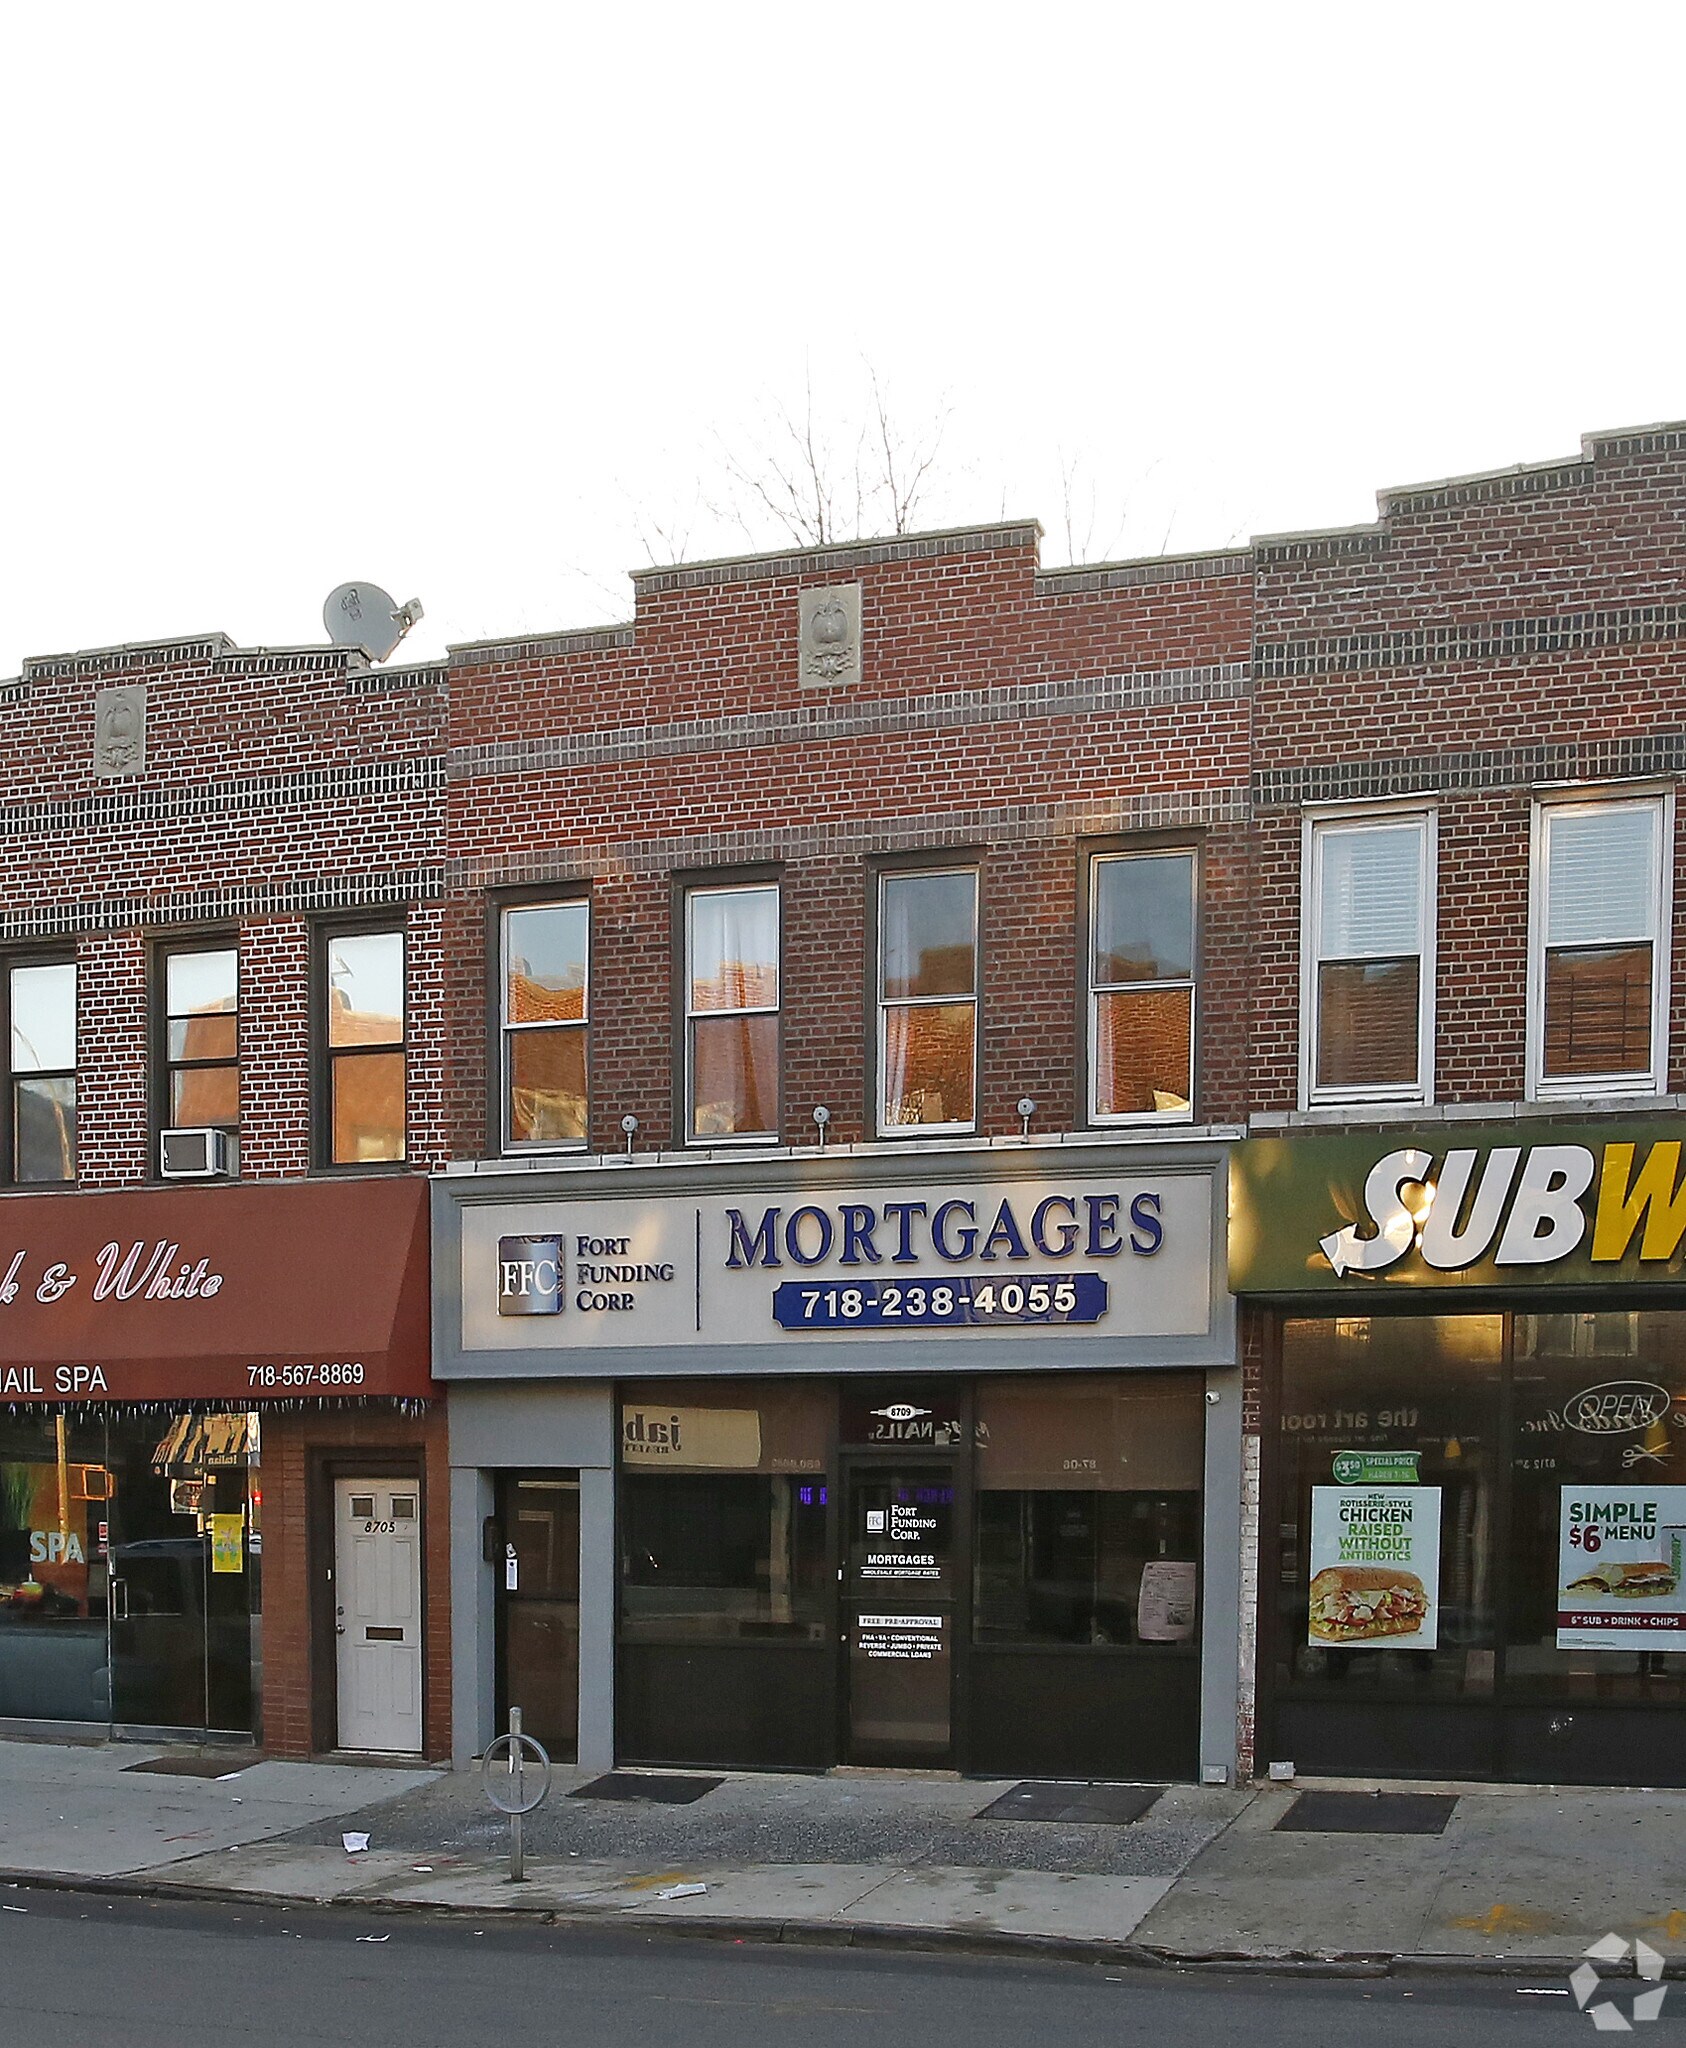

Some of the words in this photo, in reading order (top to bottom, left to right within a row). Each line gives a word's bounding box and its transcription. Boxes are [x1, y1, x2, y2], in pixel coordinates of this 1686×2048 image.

[724, 1191, 1166, 1269] MORTGAGES
[36, 1262, 77, 1303] &
[93, 1239, 223, 1301] White
[501, 1259, 557, 1297] FFC
[800, 1283, 1076, 1319] 718-238-4055
[54, 1364, 109, 1393] SPA
[246, 1362, 365, 1386] 718-567-8869
[890, 1407, 912, 1417] 8709
[1578, 1395, 1655, 1419] OPEN
[1339, 1508, 1413, 1522] CHICKEN
[1569, 1503, 1657, 1522] SIMPLE
[364, 1521, 396, 1533] 8705
[1348, 1523, 1403, 1536] RAISED
[30, 1531, 85, 1564] SPA
[1339, 1537, 1412, 1550] WITHOUT
[1569, 1524, 1601, 1552] $6
[1604, 1526, 1656, 1540] MENU
[867, 1554, 935, 1565] MORTGAGES
[1338, 1551, 1411, 1561] ANTIBIOTICS
[1582, 1616, 1602, 1625] SUB
[1611, 1617, 1641, 1626] DRINK
[1650, 1617, 1679, 1626] CHIPS
